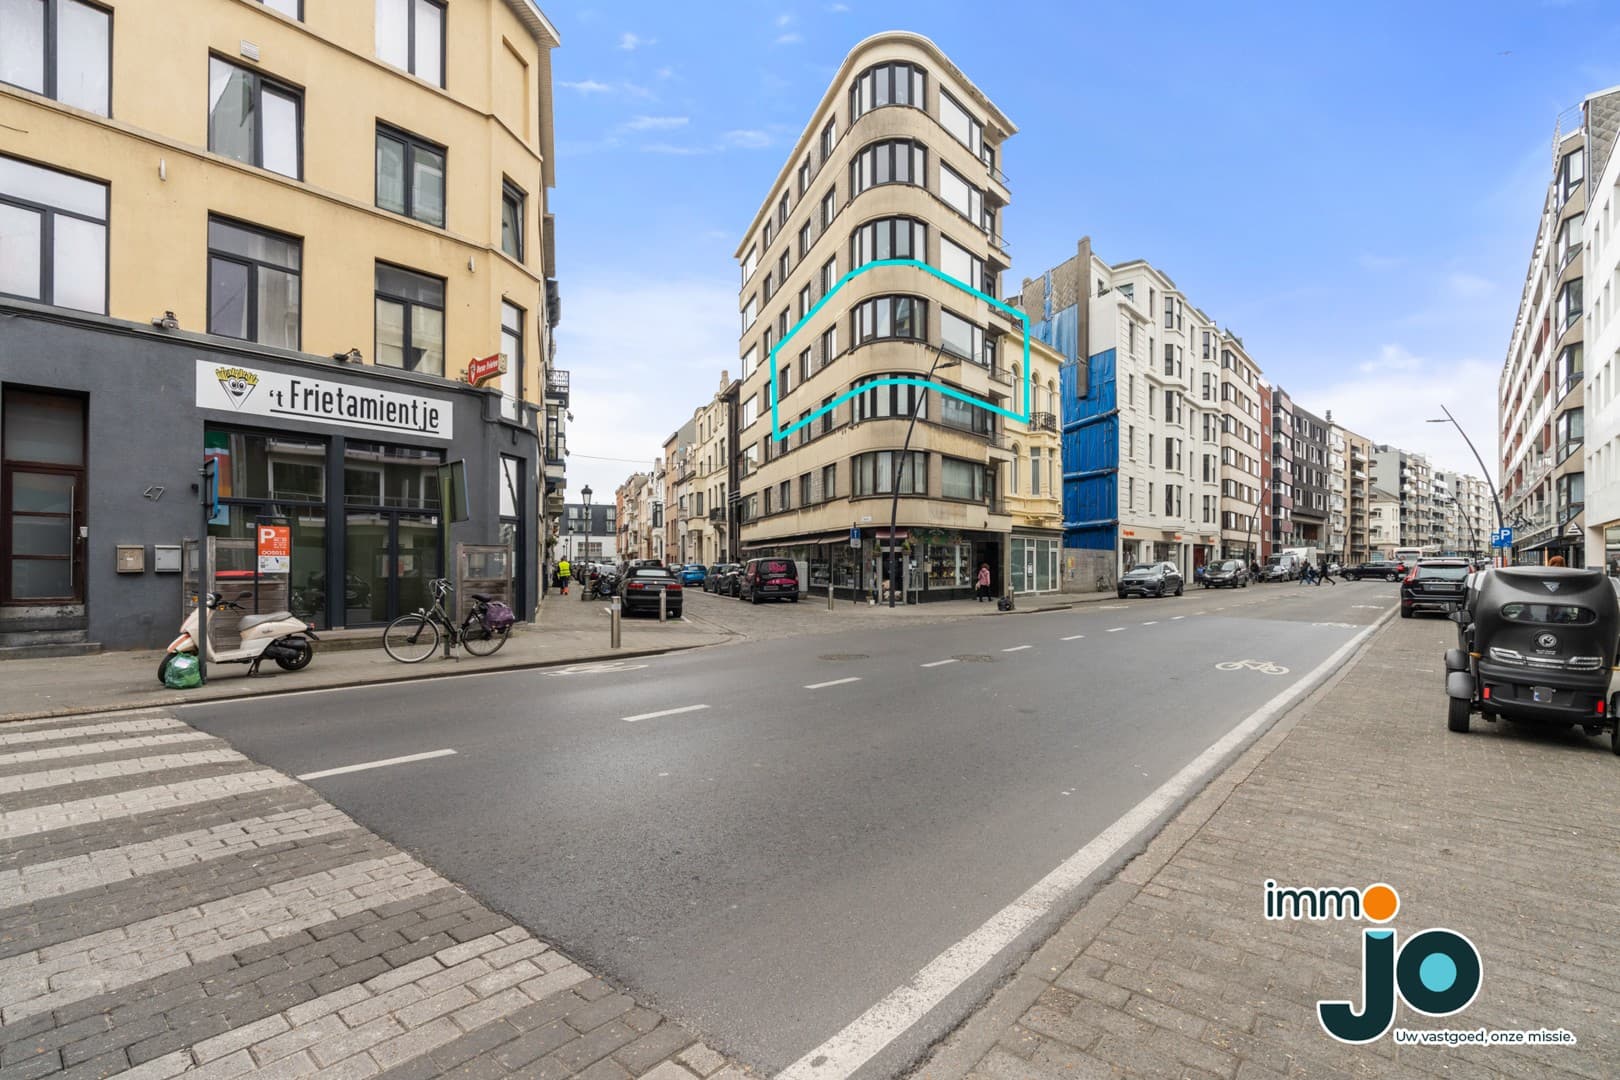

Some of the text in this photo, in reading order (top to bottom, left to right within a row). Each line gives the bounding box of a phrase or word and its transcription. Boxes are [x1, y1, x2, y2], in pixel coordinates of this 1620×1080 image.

[290, 380, 440, 431] Frietamientje
[143, 486, 165, 502] 47
[260, 528, 276, 544] P
[1492, 534, 1500, 544] P
[1500, 529, 1511, 540] P
